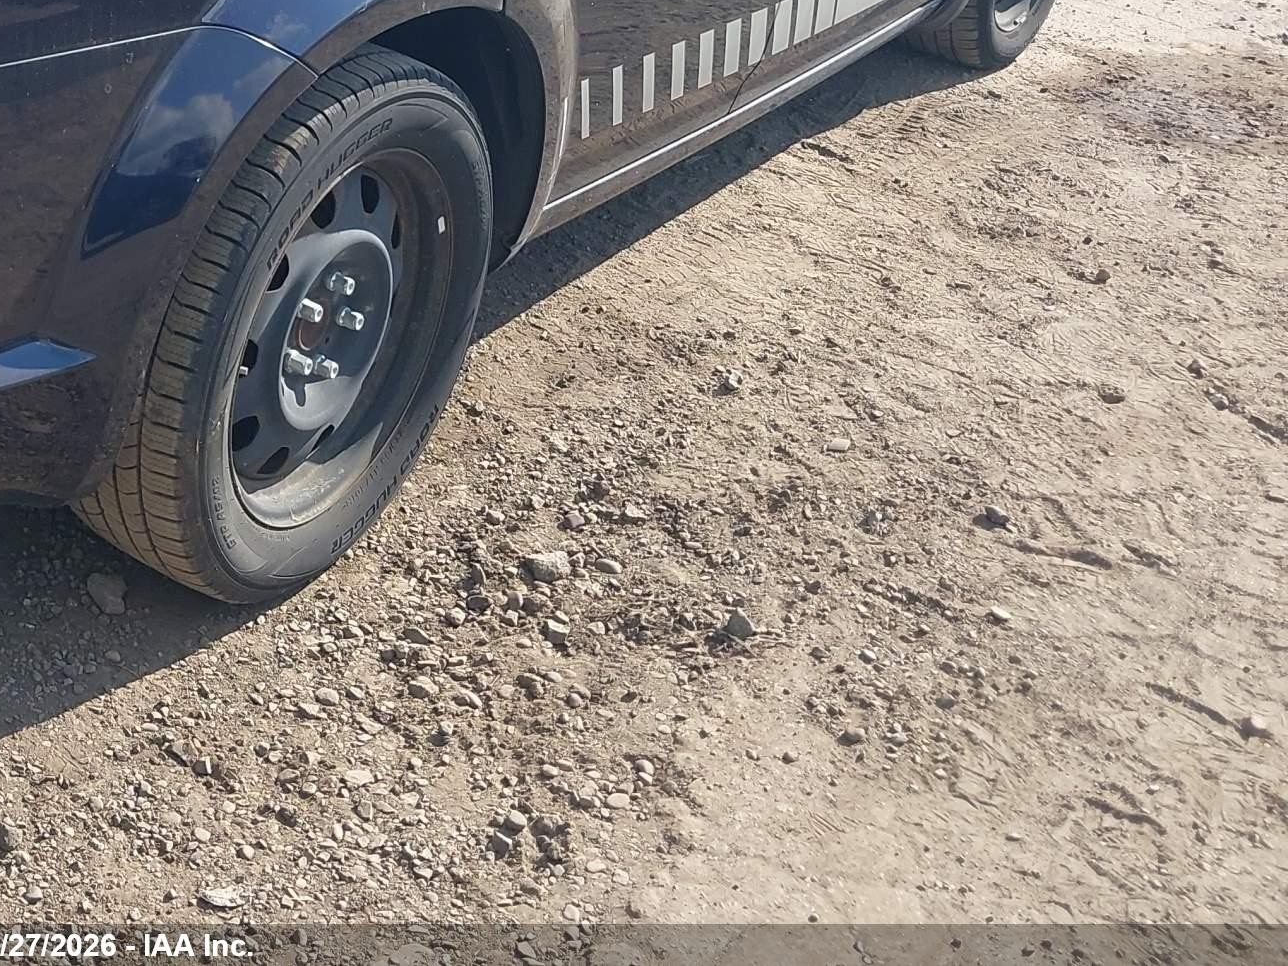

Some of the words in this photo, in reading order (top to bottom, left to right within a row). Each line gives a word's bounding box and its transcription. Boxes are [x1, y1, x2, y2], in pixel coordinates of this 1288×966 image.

[266, 189, 314, 270] ROAD
[318, 117, 393, 191] HUGGER
[399, 403, 440, 476] ROAD
[330, 476, 398, 555] HUGGER
